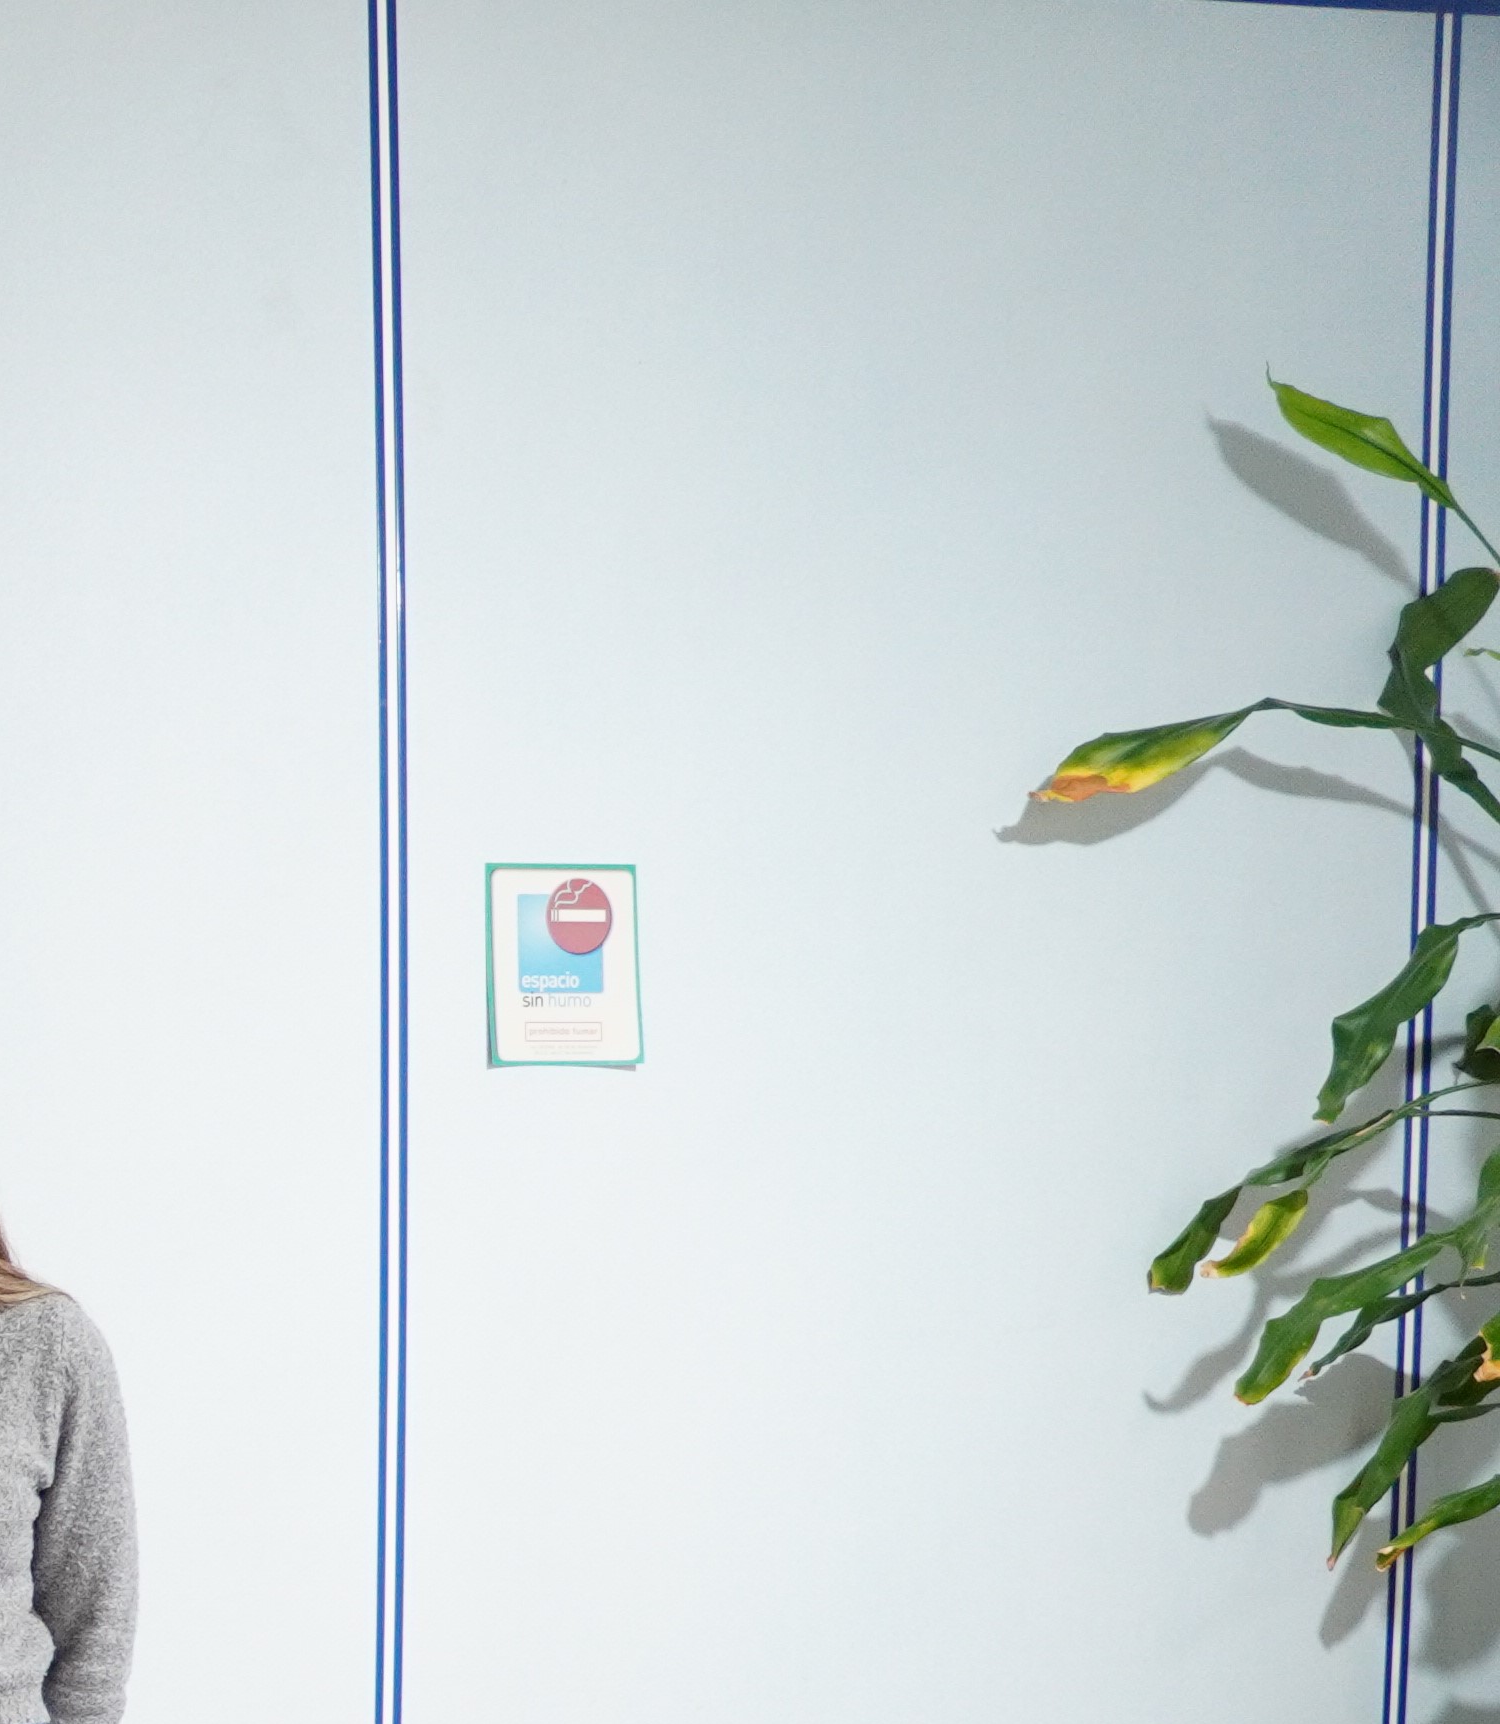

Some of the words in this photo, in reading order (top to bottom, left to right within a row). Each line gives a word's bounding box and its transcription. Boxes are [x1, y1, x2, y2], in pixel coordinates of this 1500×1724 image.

[522, 972, 580, 992] espacio
[522, 991, 544, 1008] sin
[548, 993, 592, 1008] humo
